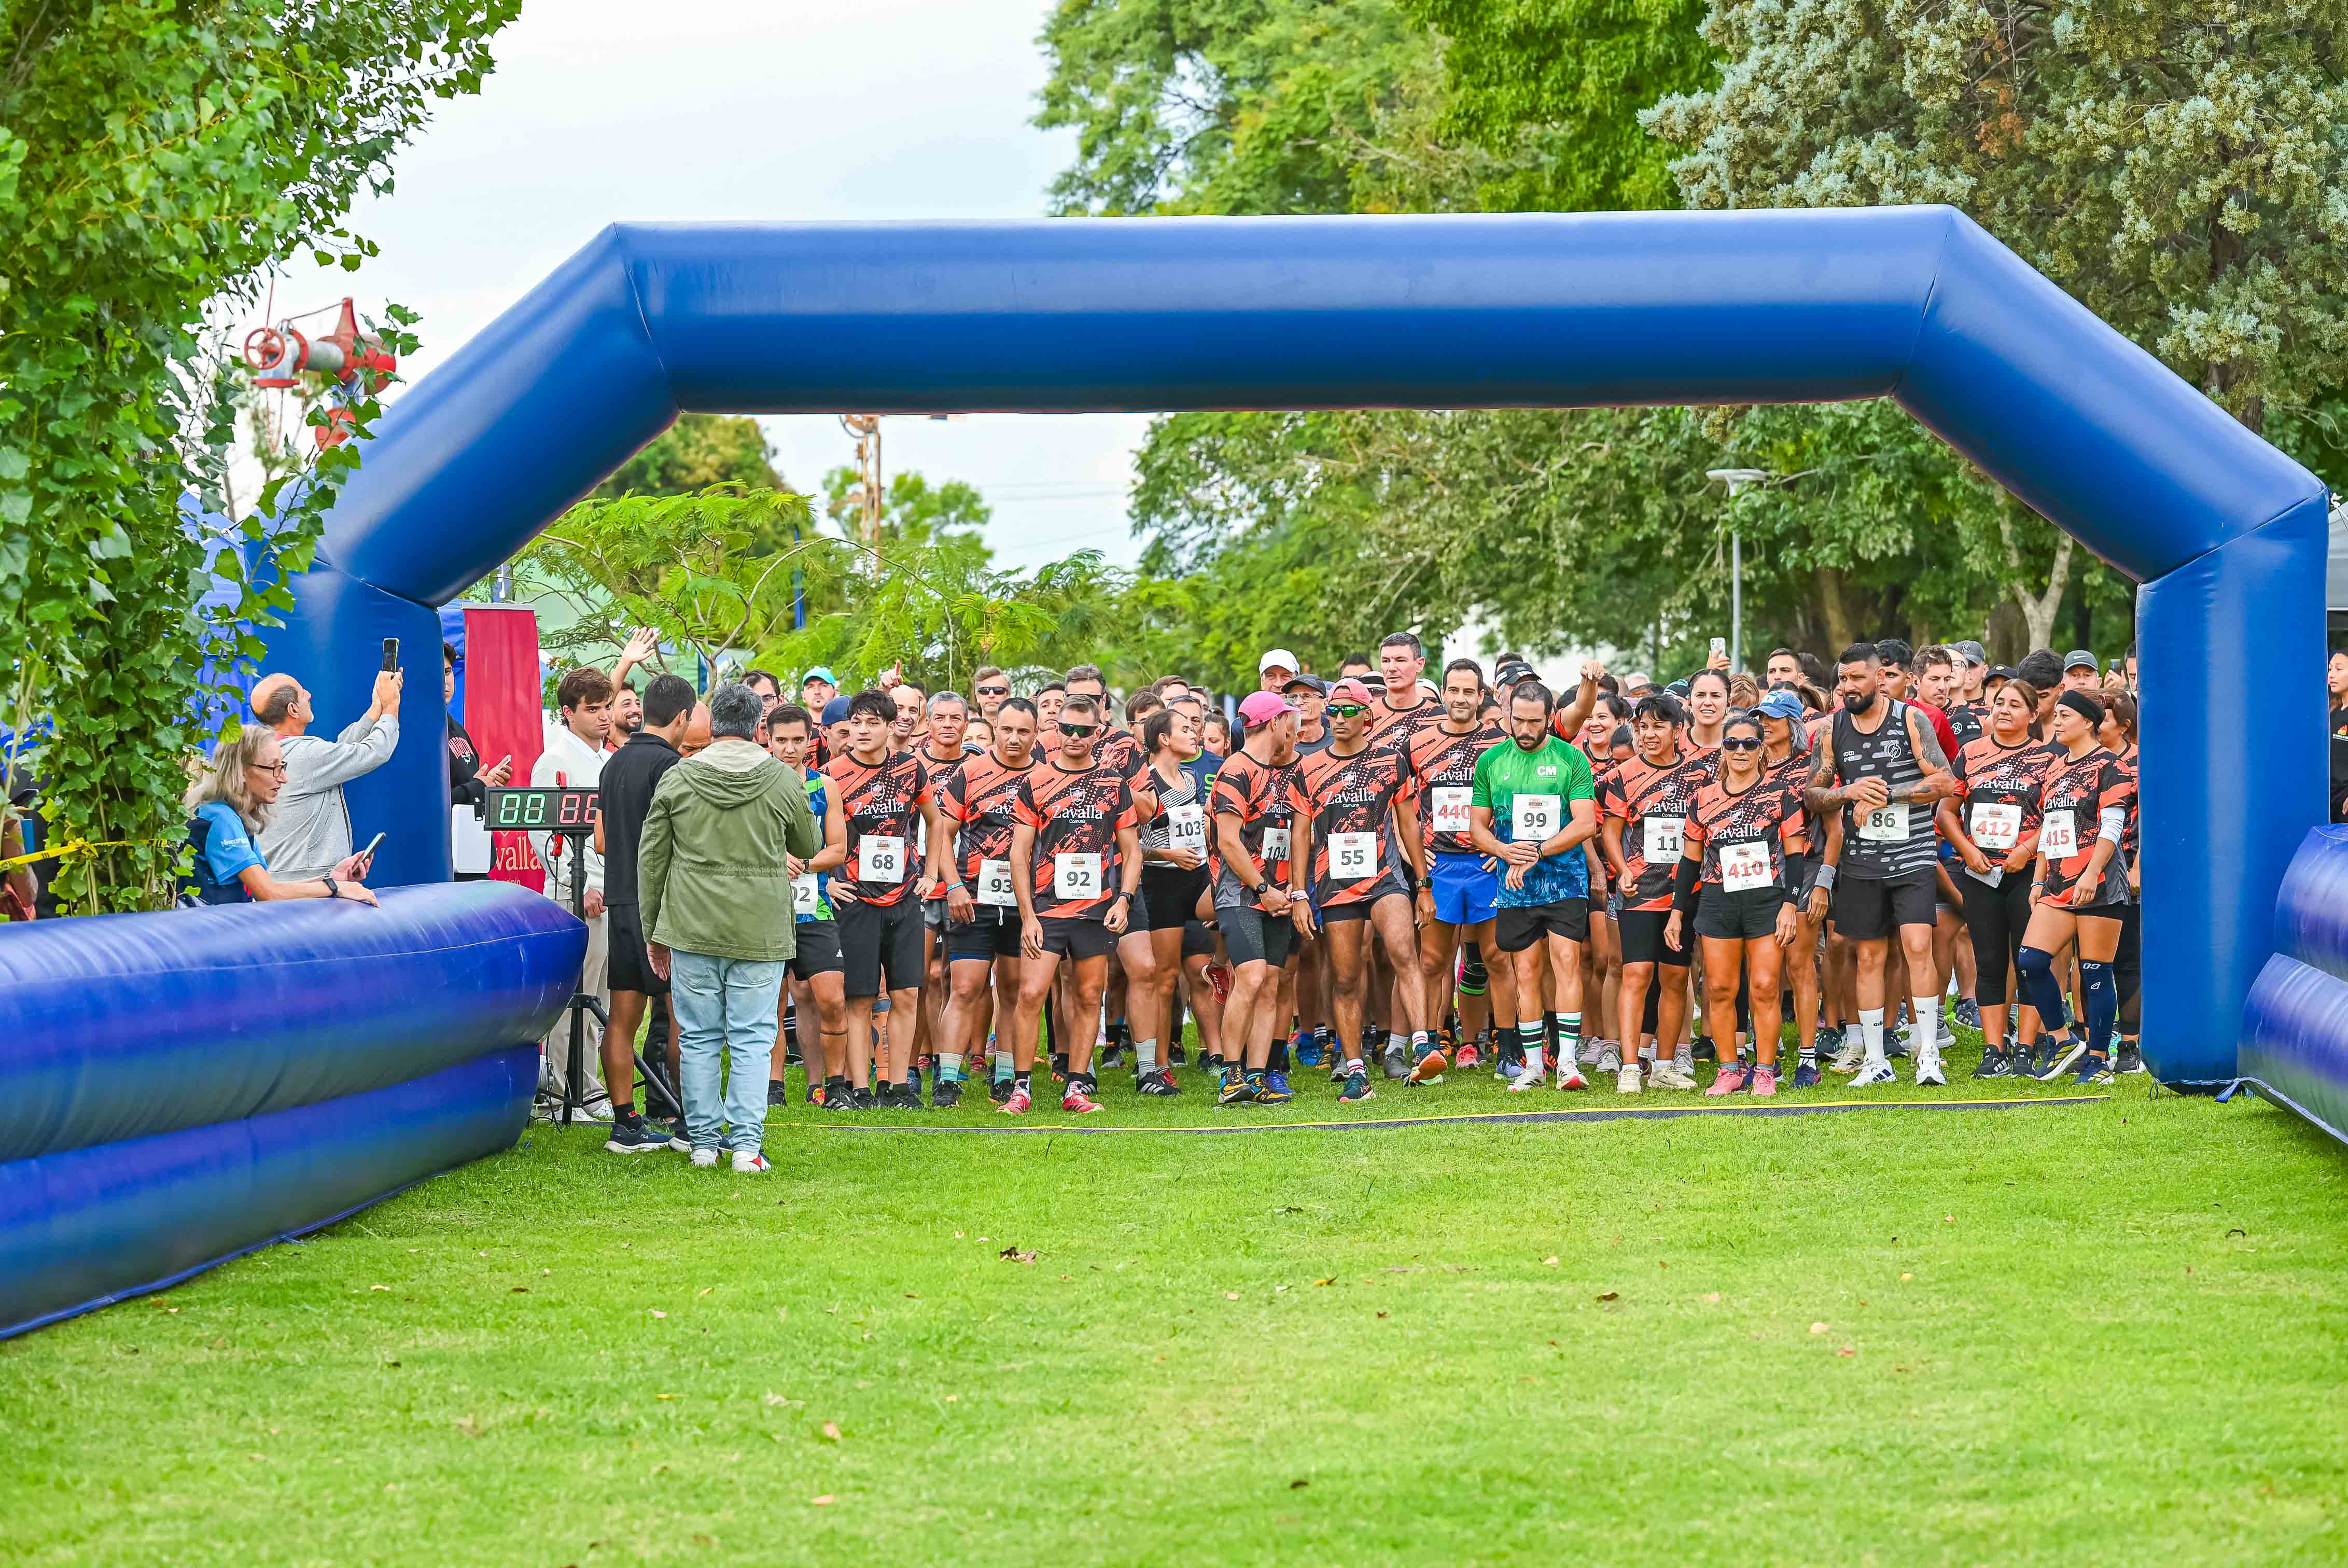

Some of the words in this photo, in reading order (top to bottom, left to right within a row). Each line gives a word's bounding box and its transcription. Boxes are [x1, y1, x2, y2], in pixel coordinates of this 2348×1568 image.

[1430, 767, 1473, 781] Zavall
[1536, 766, 1557, 776] CM
[1974, 778, 2028, 791] Zavalla
[1324, 788, 1376, 805] Zavalla
[853, 799, 904, 816] Zavalla
[1052, 804, 1103, 820] Zavalla
[1438, 804, 1471, 819] 440
[1643, 799, 1687, 813] Zavall
[1524, 813, 1547, 828] 99
[1872, 813, 1895, 828] 86
[1176, 821, 1201, 837] 103
[1711, 823, 1762, 839] Zavalla
[1976, 821, 2011, 836] 412
[1657, 836, 1679, 851] 11
[2046, 829, 2069, 846] 415
[1266, 846, 1287, 860] 104
[1341, 850, 1364, 865] 55
[872, 854, 894, 870] 68
[1728, 860, 1763, 878] 410
[991, 878, 1013, 893] 93
[1067, 871, 1090, 886] 92
